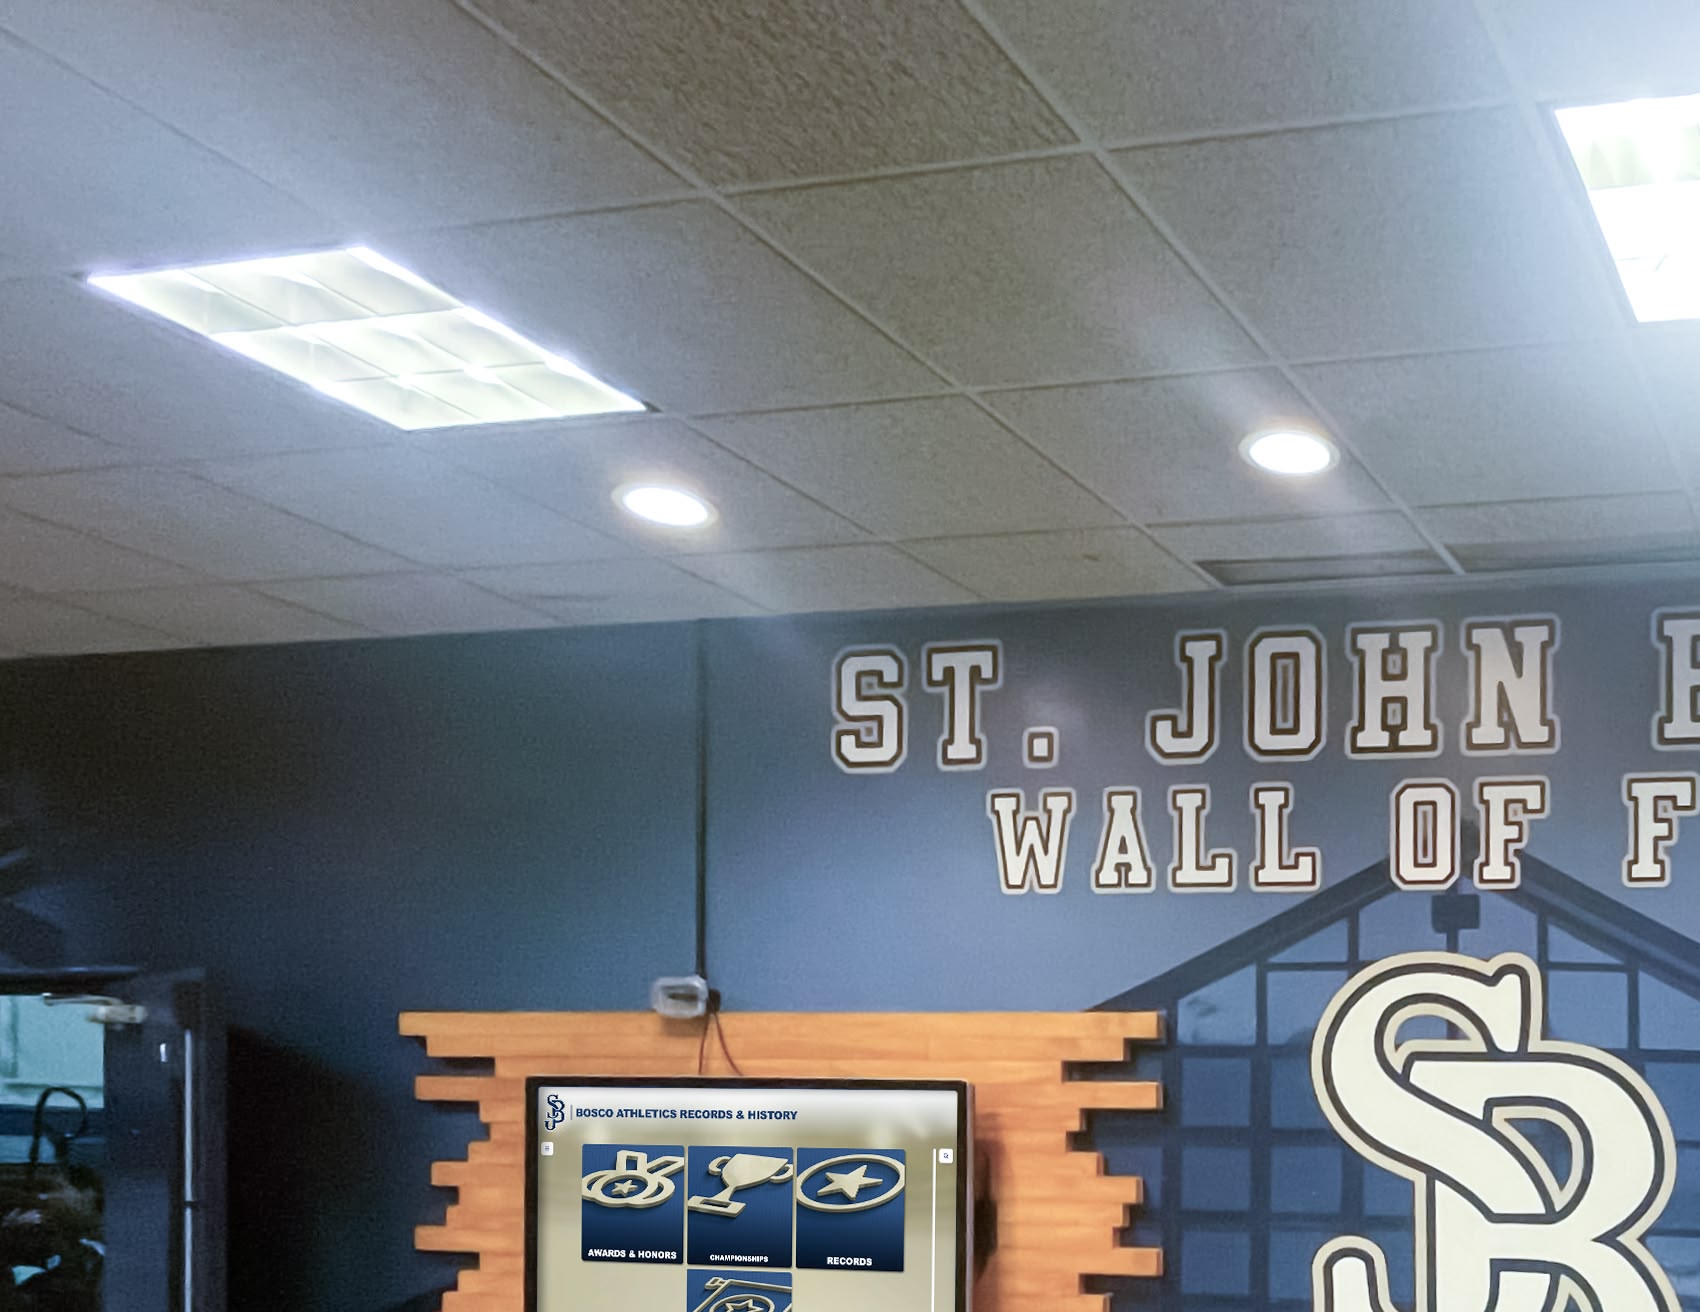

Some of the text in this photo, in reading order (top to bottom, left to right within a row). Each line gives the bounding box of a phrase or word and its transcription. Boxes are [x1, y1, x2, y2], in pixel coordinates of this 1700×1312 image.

[832, 643, 1058, 773] ST.
[1147, 614, 1560, 764] JOHN
[990, 784, 1323, 893] WALL
[1391, 777, 1548, 892] OF
[576, 1108, 798, 1121] BOSCO ATHLETICS RECORDS & HISTORY
[588, 1248, 677, 1260] AWARDS & HONORS
[709, 1253, 769, 1263] CHAMPIONSHIPS
[827, 1256, 873, 1266] RECORDS
